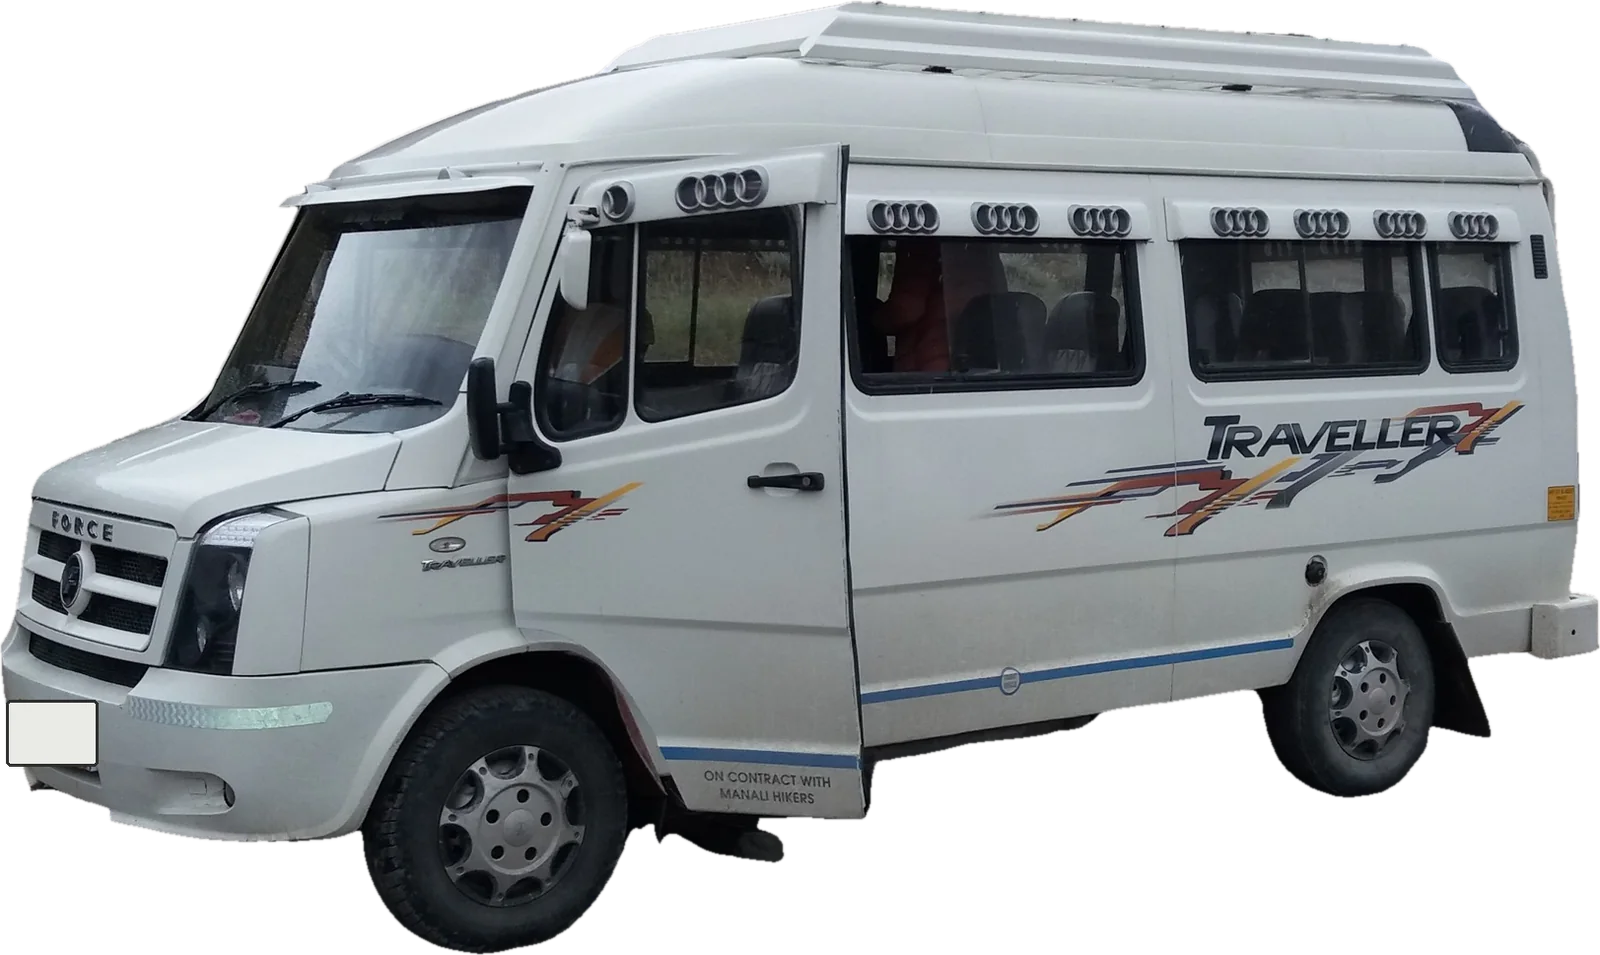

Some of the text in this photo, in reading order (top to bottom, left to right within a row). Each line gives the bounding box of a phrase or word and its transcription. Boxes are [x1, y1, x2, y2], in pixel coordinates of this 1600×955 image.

[1204, 415, 1461, 460] TRAVELLER
[52, 511, 113, 542] FORCE
[704, 770, 831, 788] ON CONTRACT WITH
[720, 788, 815, 804] MANALI HIKERS
